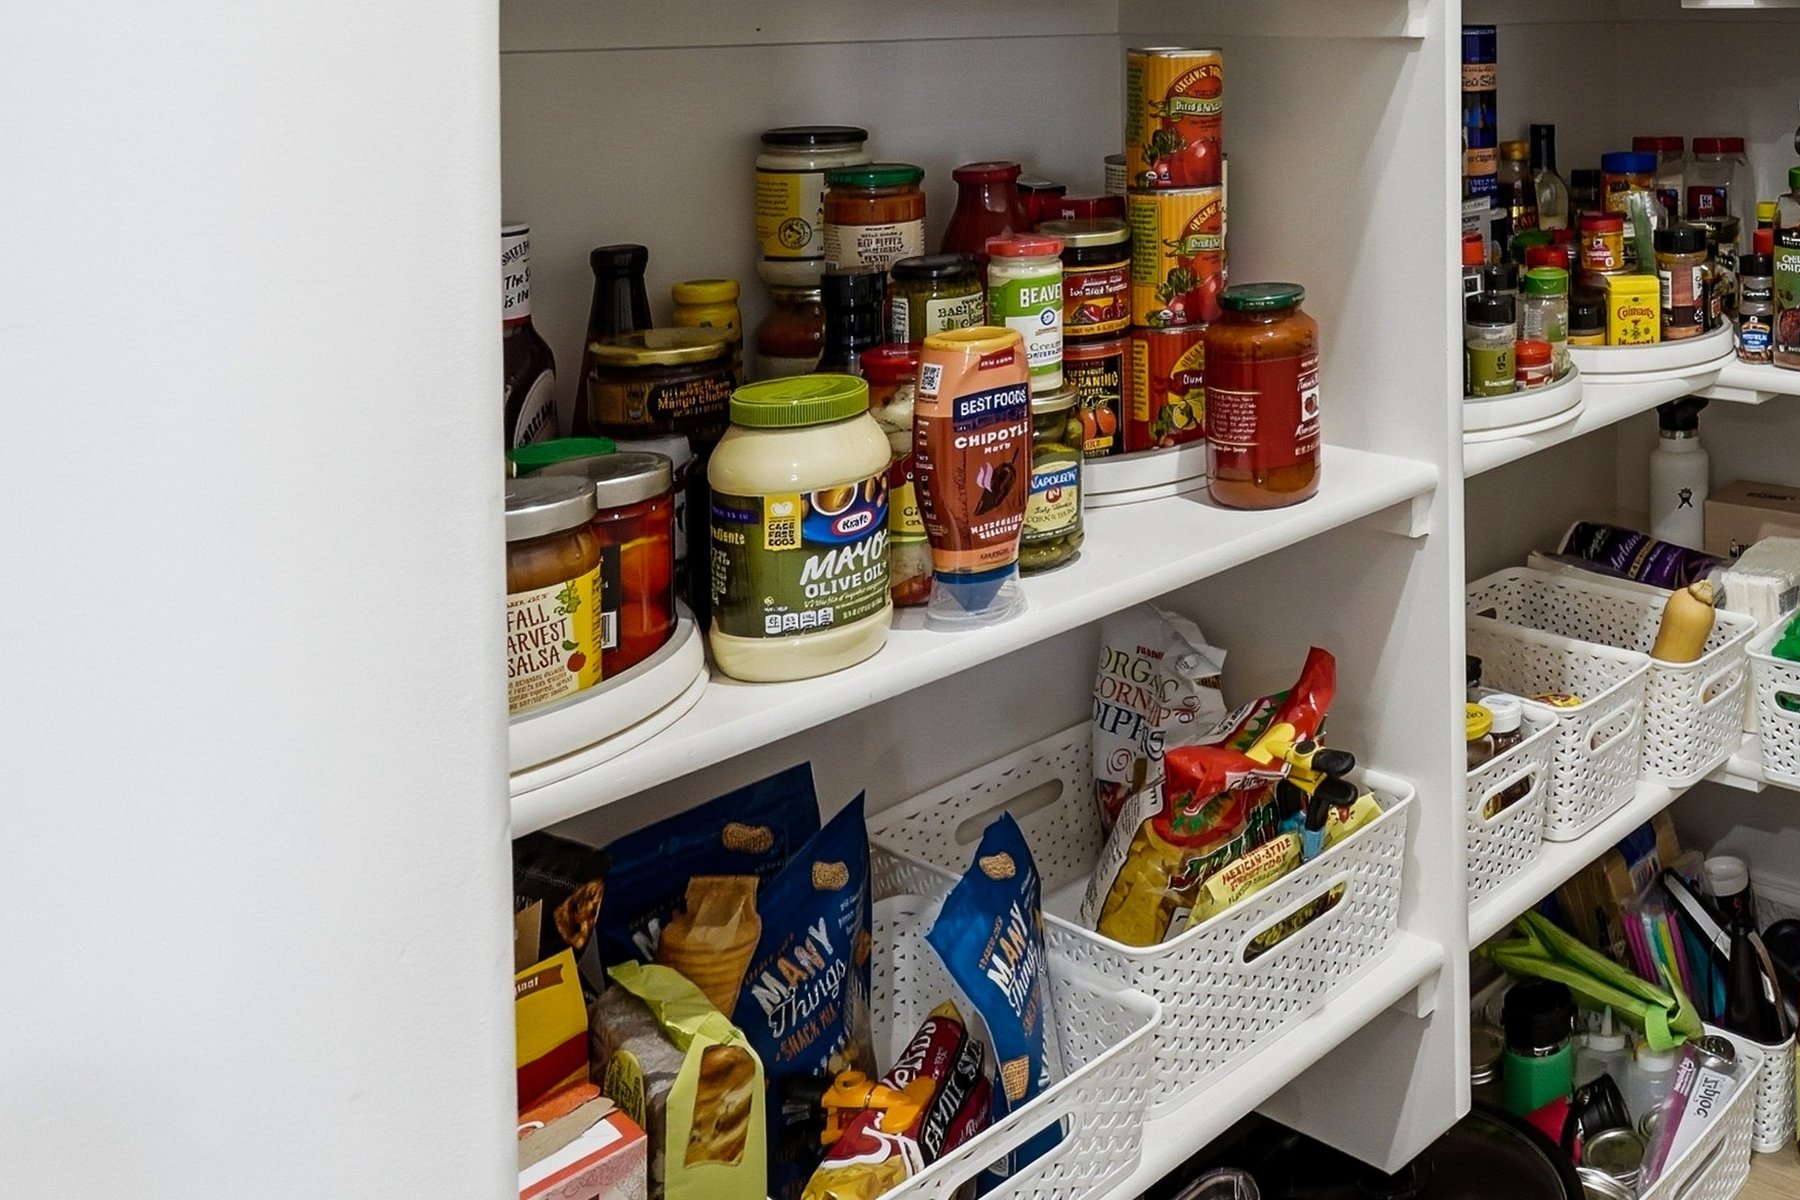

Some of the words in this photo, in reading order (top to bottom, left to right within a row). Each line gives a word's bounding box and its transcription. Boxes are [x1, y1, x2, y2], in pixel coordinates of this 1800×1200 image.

[504, 272, 524, 291] The
[961, 396, 992, 416] BEST
[994, 389, 1026, 407] FOODS
[841, 515, 869, 531] Kraft
[800, 530, 886, 586] MAYO
[805, 573, 862, 599] OLIVE
[507, 604, 550, 633] FALL
[507, 617, 568, 655] ARVEST
[508, 645, 561, 679] SALSA
[751, 916, 834, 1017] MANY
[986, 899, 1030, 998] MANY
[768, 957, 848, 1039] Things
[779, 1019, 821, 1062] SNACK
